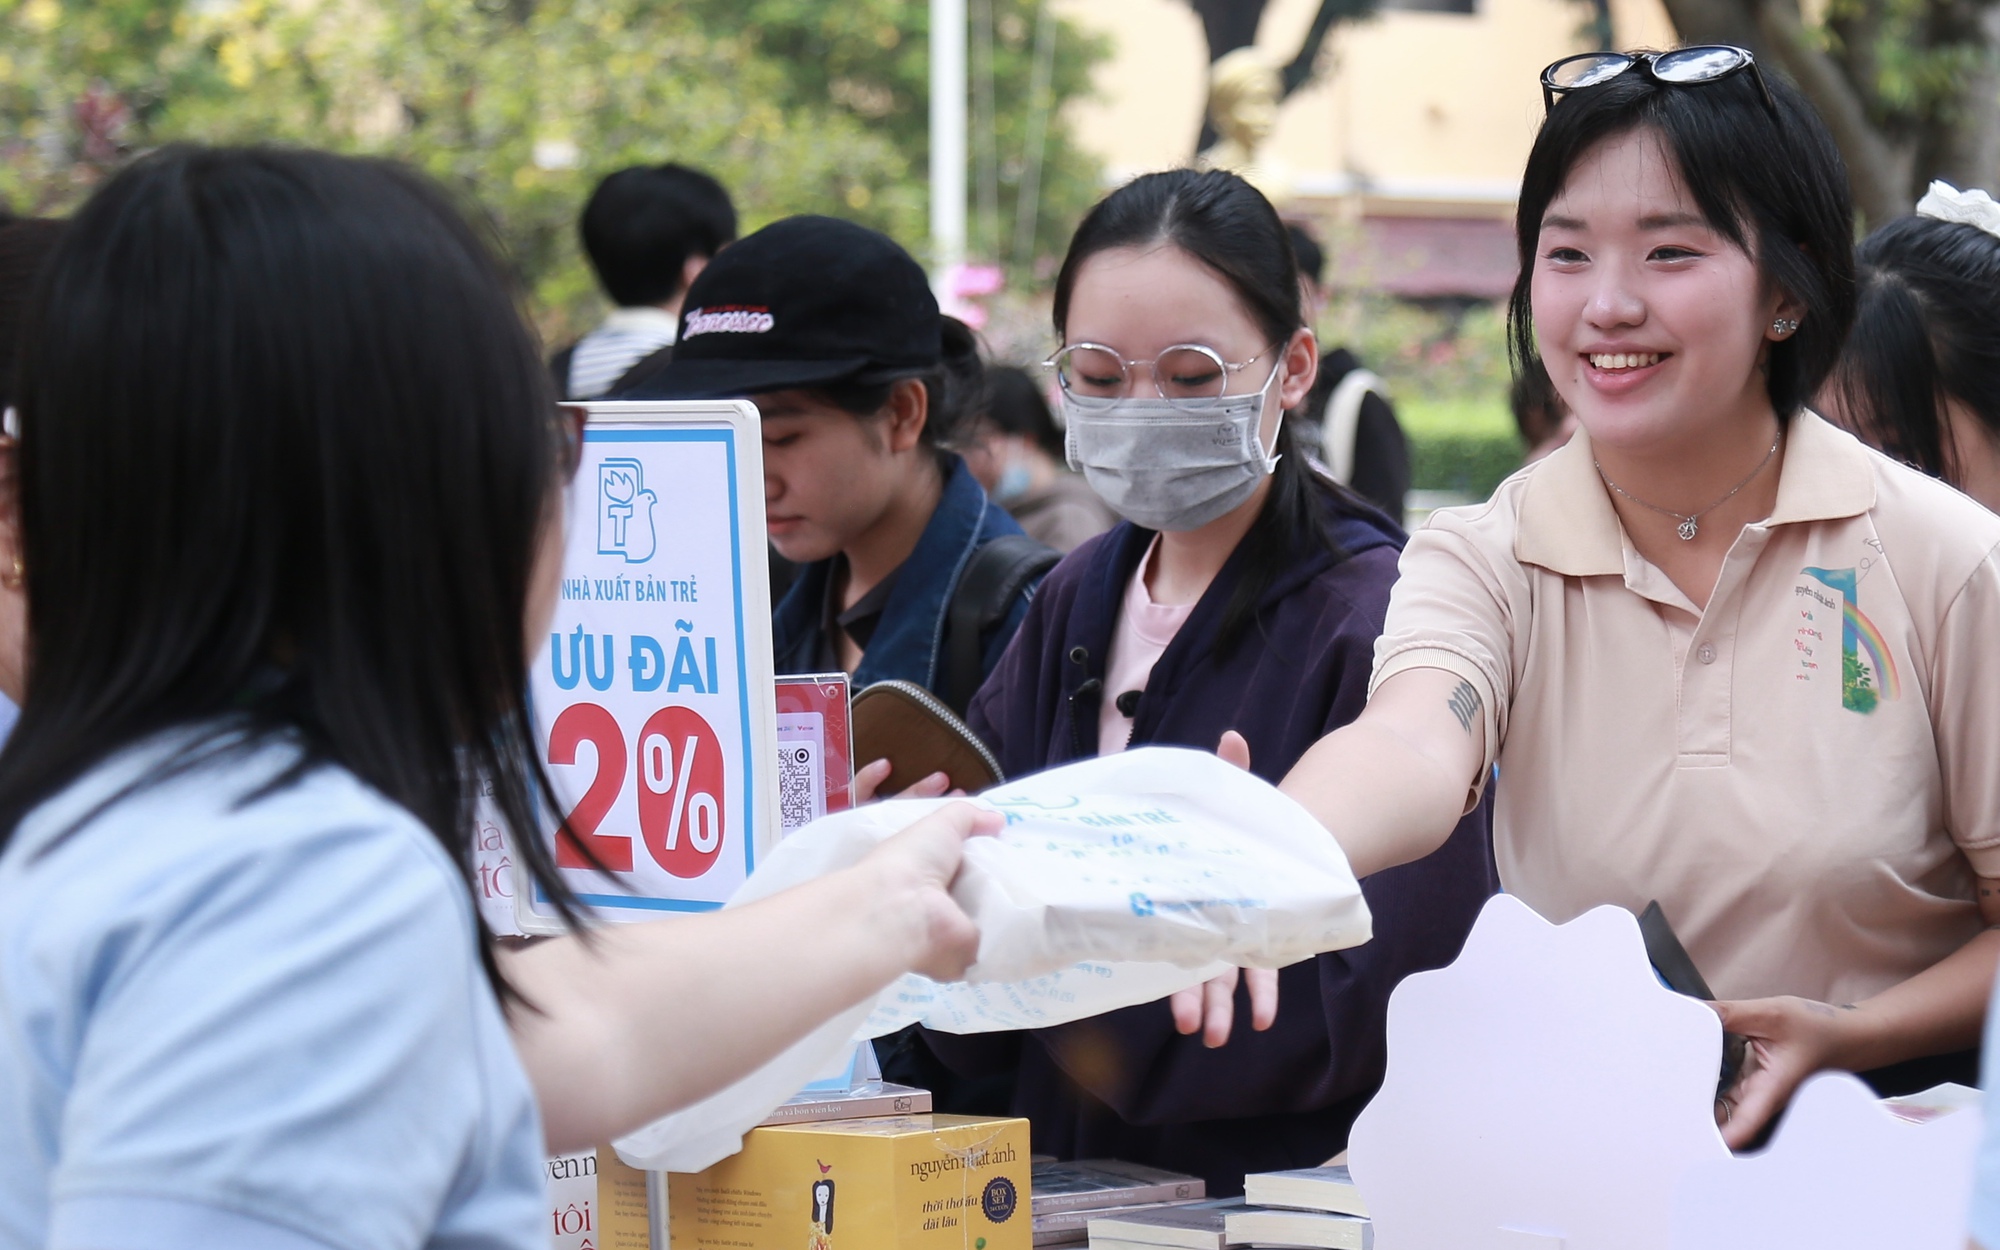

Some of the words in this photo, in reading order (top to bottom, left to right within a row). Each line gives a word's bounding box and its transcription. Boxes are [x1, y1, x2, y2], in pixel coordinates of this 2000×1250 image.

[561, 574, 591, 601] NHÀ
[594, 573, 631, 602] XUẤT
[635, 573, 666, 602] BẢN
[670, 574, 698, 603] TRẺ
[550, 622, 615, 692] ƯU
[628, 618, 719, 695] ĐÃI
[911, 1153, 959, 1182] nguyễn
[992, 1142, 1016, 1166] ánh
[991, 1187, 1007, 1197] BOX
[992, 1196, 1006, 1205] SET
[922, 1200, 943, 1214] thời
[552, 1201, 592, 1236] tôi
[923, 1217, 939, 1231] dài
[942, 1216, 958, 1228] lâu
